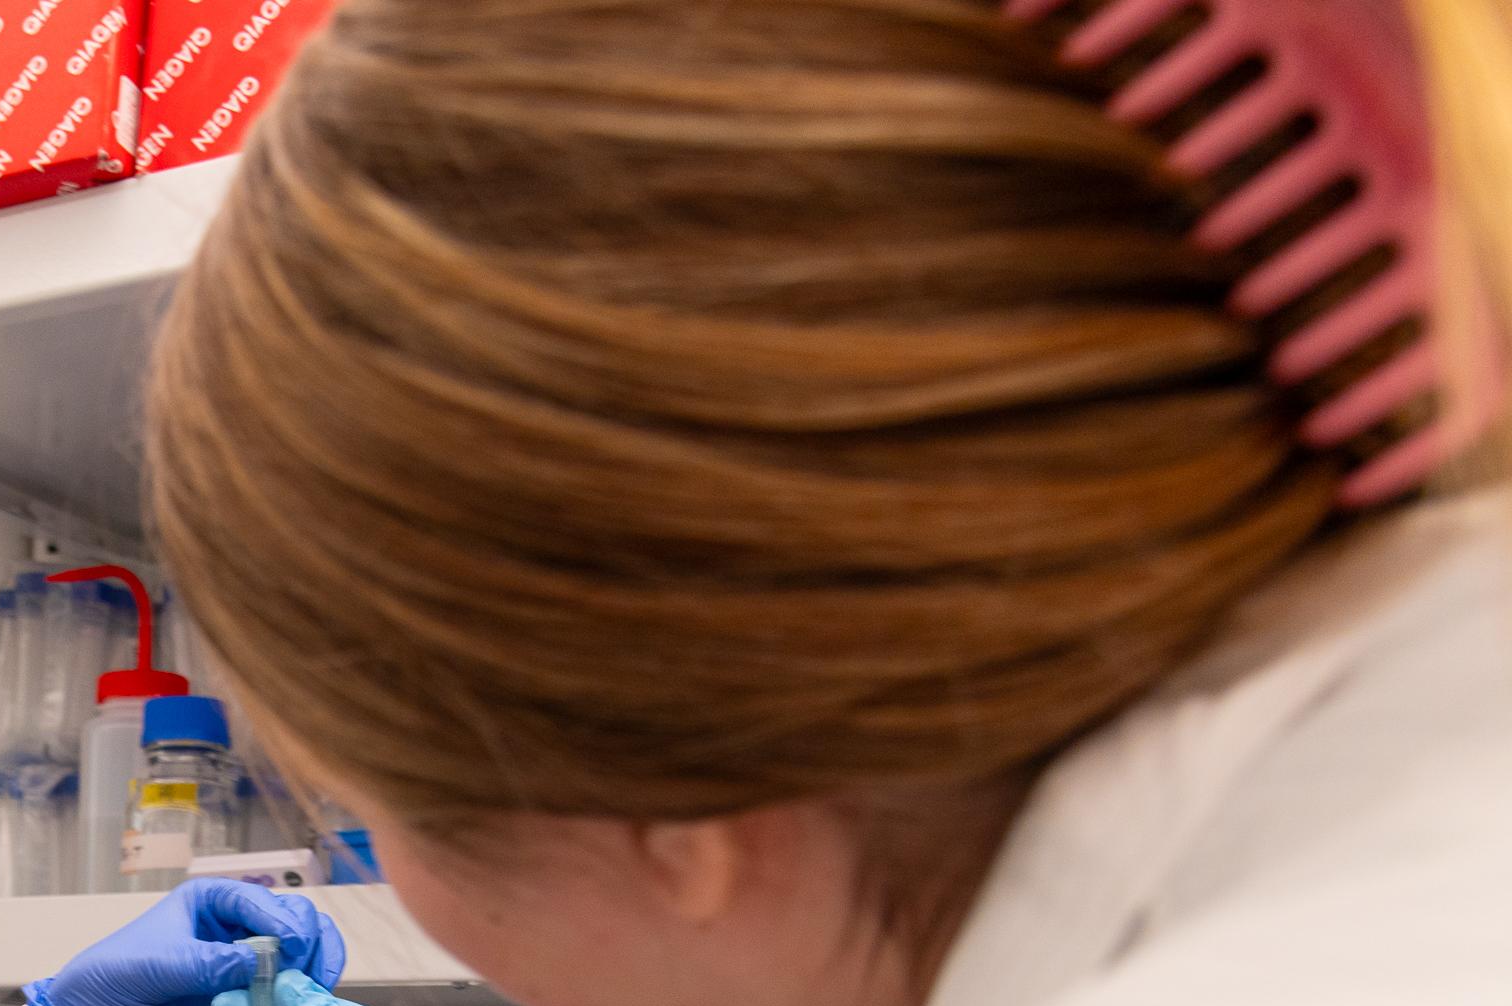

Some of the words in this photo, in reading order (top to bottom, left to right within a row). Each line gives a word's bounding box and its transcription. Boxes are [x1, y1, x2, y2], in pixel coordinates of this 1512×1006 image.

[66, 6, 128, 75] QIAGEN
[232, 0, 287, 52] QIAG
[143, 27, 212, 101] QIAGEN
[29, 96, 93, 173] QIAGEN
[191, 76, 260, 152] QIAGEN
